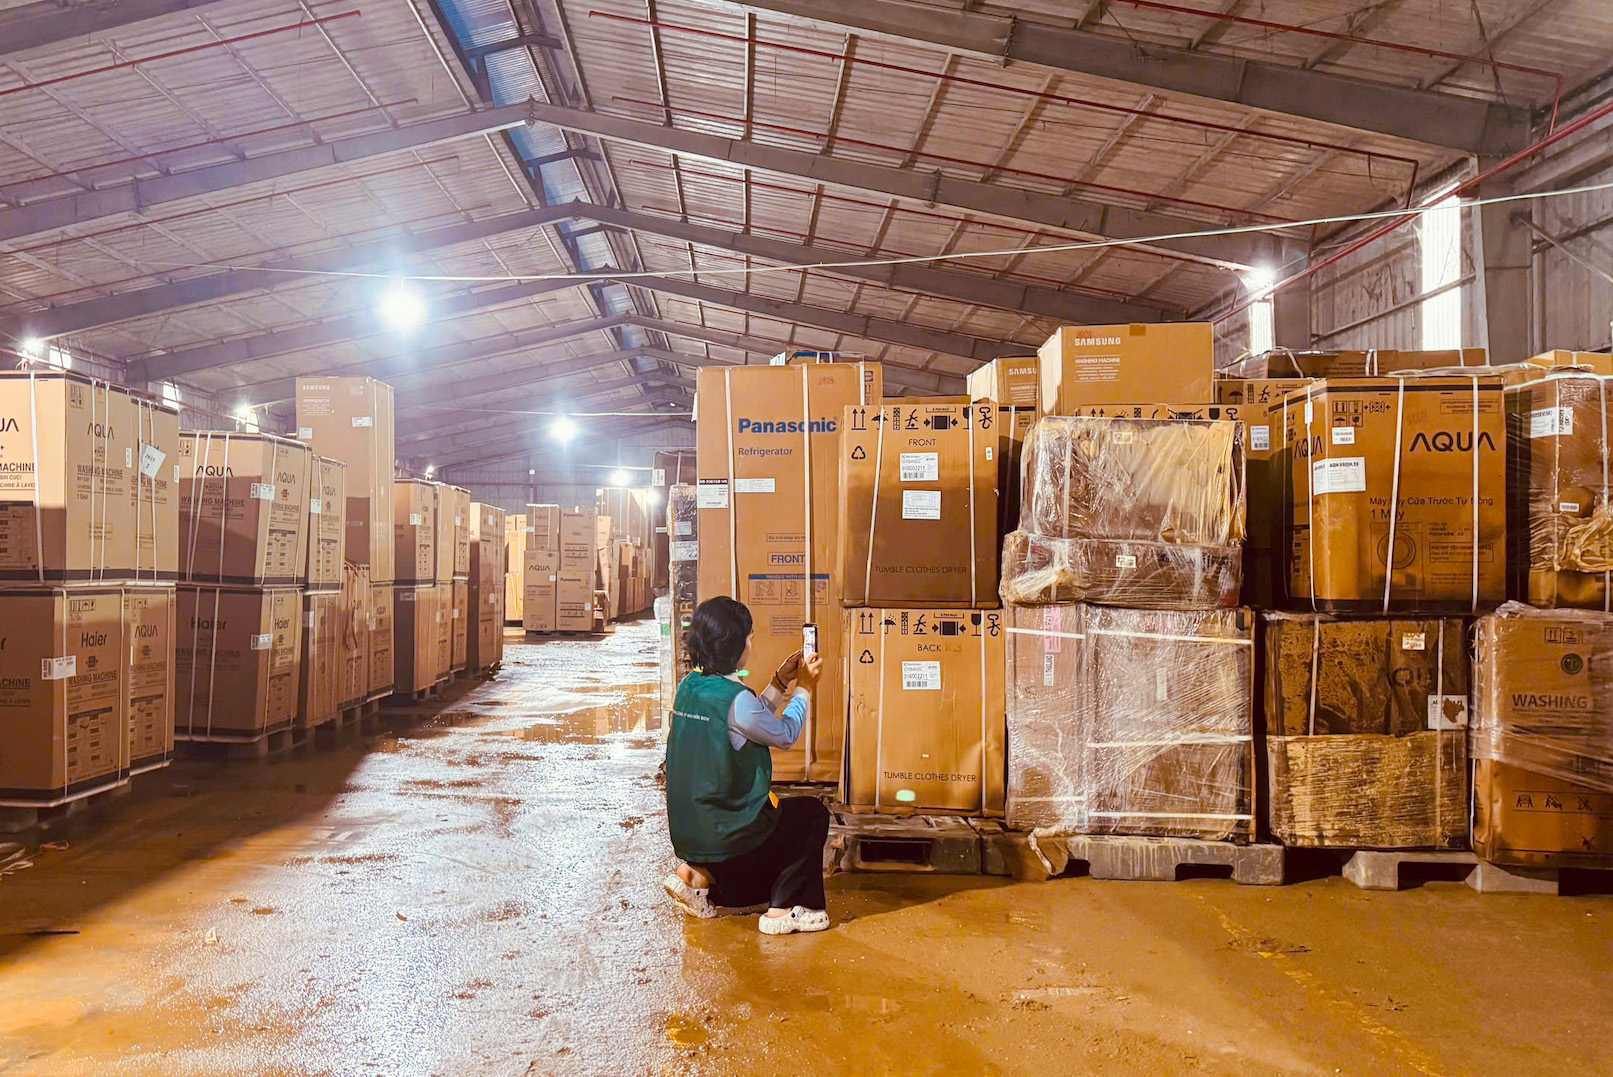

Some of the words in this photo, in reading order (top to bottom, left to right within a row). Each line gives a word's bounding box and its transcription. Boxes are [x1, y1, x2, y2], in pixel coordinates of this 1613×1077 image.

[1074, 337, 1121, 346] SAMSUNG
[87, 422, 114, 440] AQUA
[738, 417, 837, 434] Panasonic
[908, 438, 936, 447] FRONT
[1294, 436, 1323, 459] AQUA
[1409, 431, 1496, 452] AQUA
[738, 447, 793, 457] Refrigerator
[196, 465, 233, 477] AQUA
[277, 472, 295, 484] AQUA
[1371, 508, 1375, 518] 1
[1381, 508, 1404, 521] My
[771, 555, 806, 563] FRONT
[275, 618, 289, 630] Haier
[135, 624, 158, 638] AQUA
[81, 631, 107, 648] Haier
[918, 644, 942, 652] BACK
[93, 670, 118, 682] MACHINE
[1512, 694, 1587, 708] WASHING
[884, 772, 912, 780] TUMBLE
[914, 772, 948, 780] CLOTHES
[951, 774, 976, 782] DRYER
